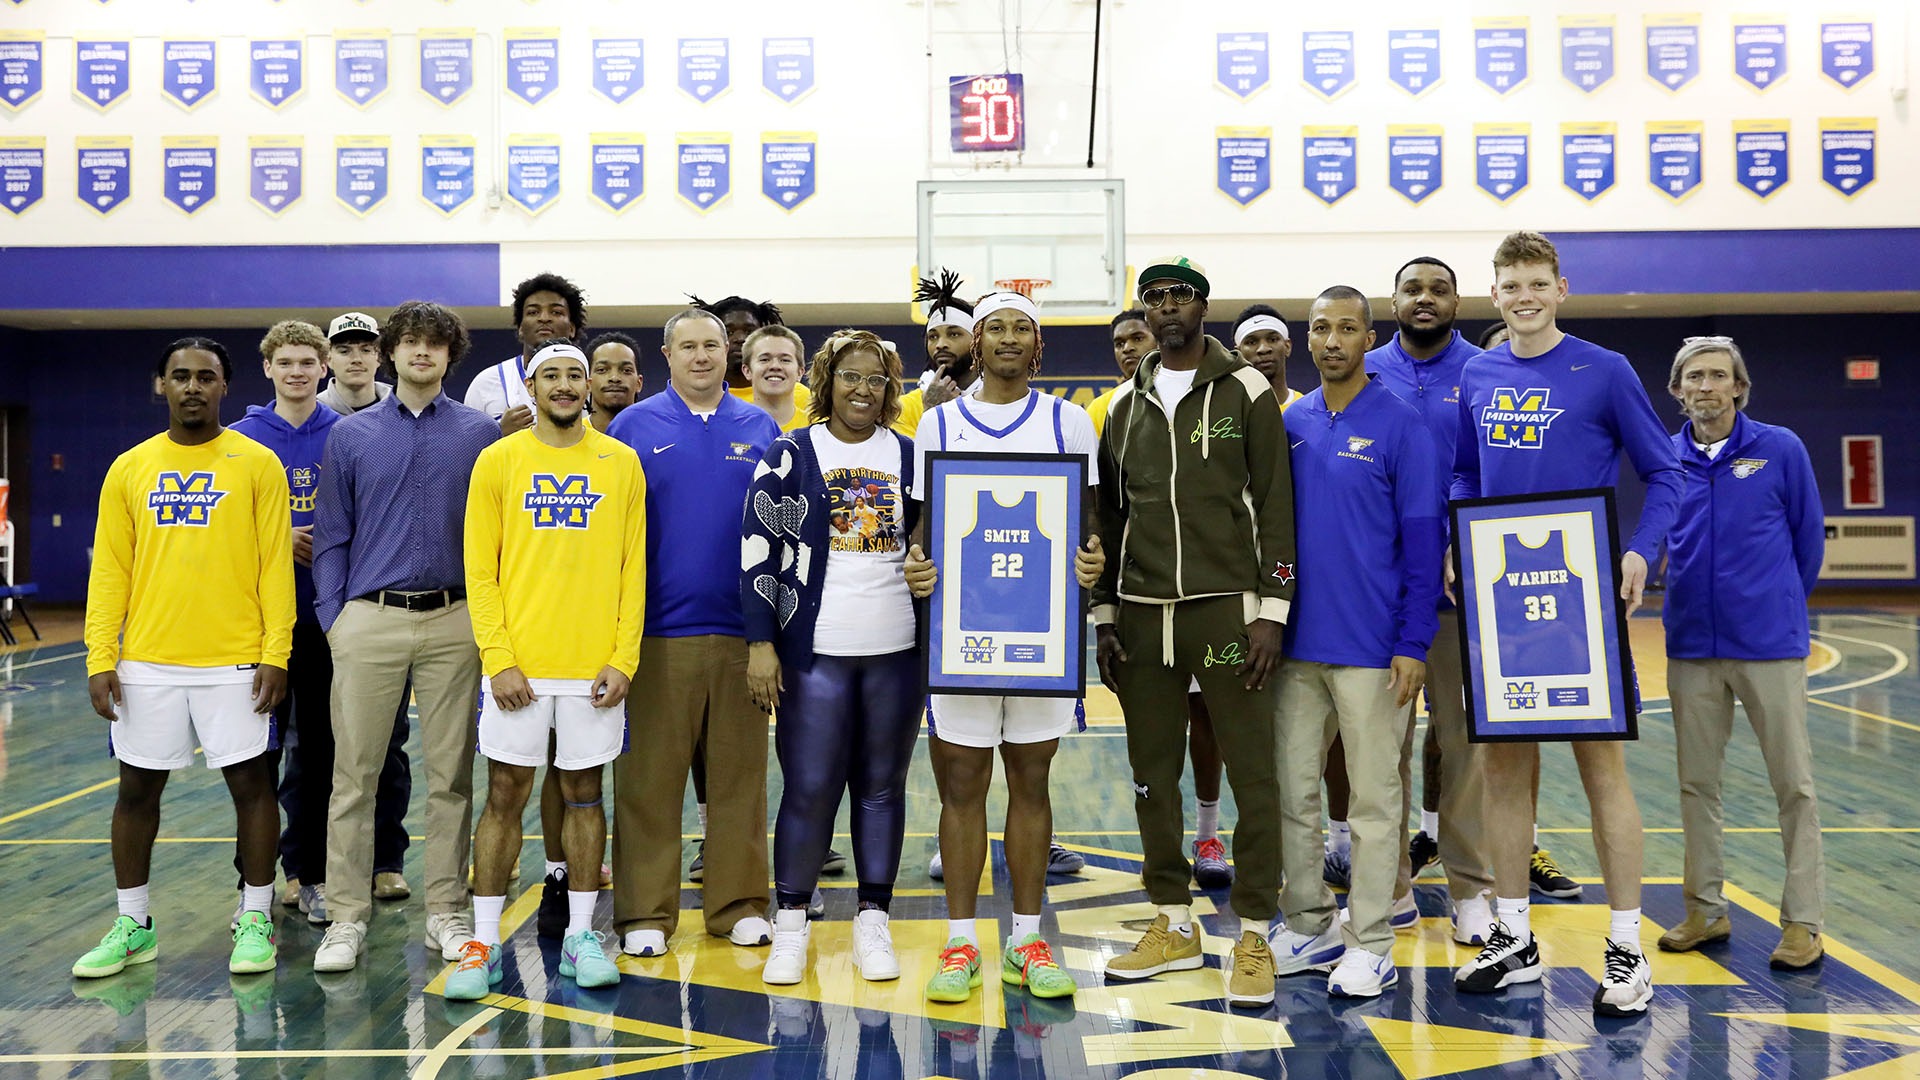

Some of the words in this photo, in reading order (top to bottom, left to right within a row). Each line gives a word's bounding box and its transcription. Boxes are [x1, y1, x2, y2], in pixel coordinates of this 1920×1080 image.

[972, 78, 1007, 94] 10:00
[962, 95, 1014, 143] 30
[606, 178, 630, 187] 2021
[693, 178, 715, 187] 2021
[776, 178, 800, 187] 2021
[1230, 173, 1256, 182] 2022
[6, 182, 30, 192] 2017
[92, 182, 116, 191] 2017
[179, 182, 202, 190] 2017
[1485, 412, 1550, 422] MIDWAY
[725, 455, 757, 464] BASKETBALL
[1337, 451, 1374, 463] BASKETBALL
[823, 468, 847, 483] APPY
[850, 467, 899, 485] BIRTHDAY
[152, 493, 217, 504] MIDWAY
[528, 495, 594, 505] MIDWAY
[984, 529, 1030, 543] SMITH
[991, 552, 1024, 578] 22
[1506, 569, 1568, 586] WARNER
[1524, 594, 1558, 621] 33
